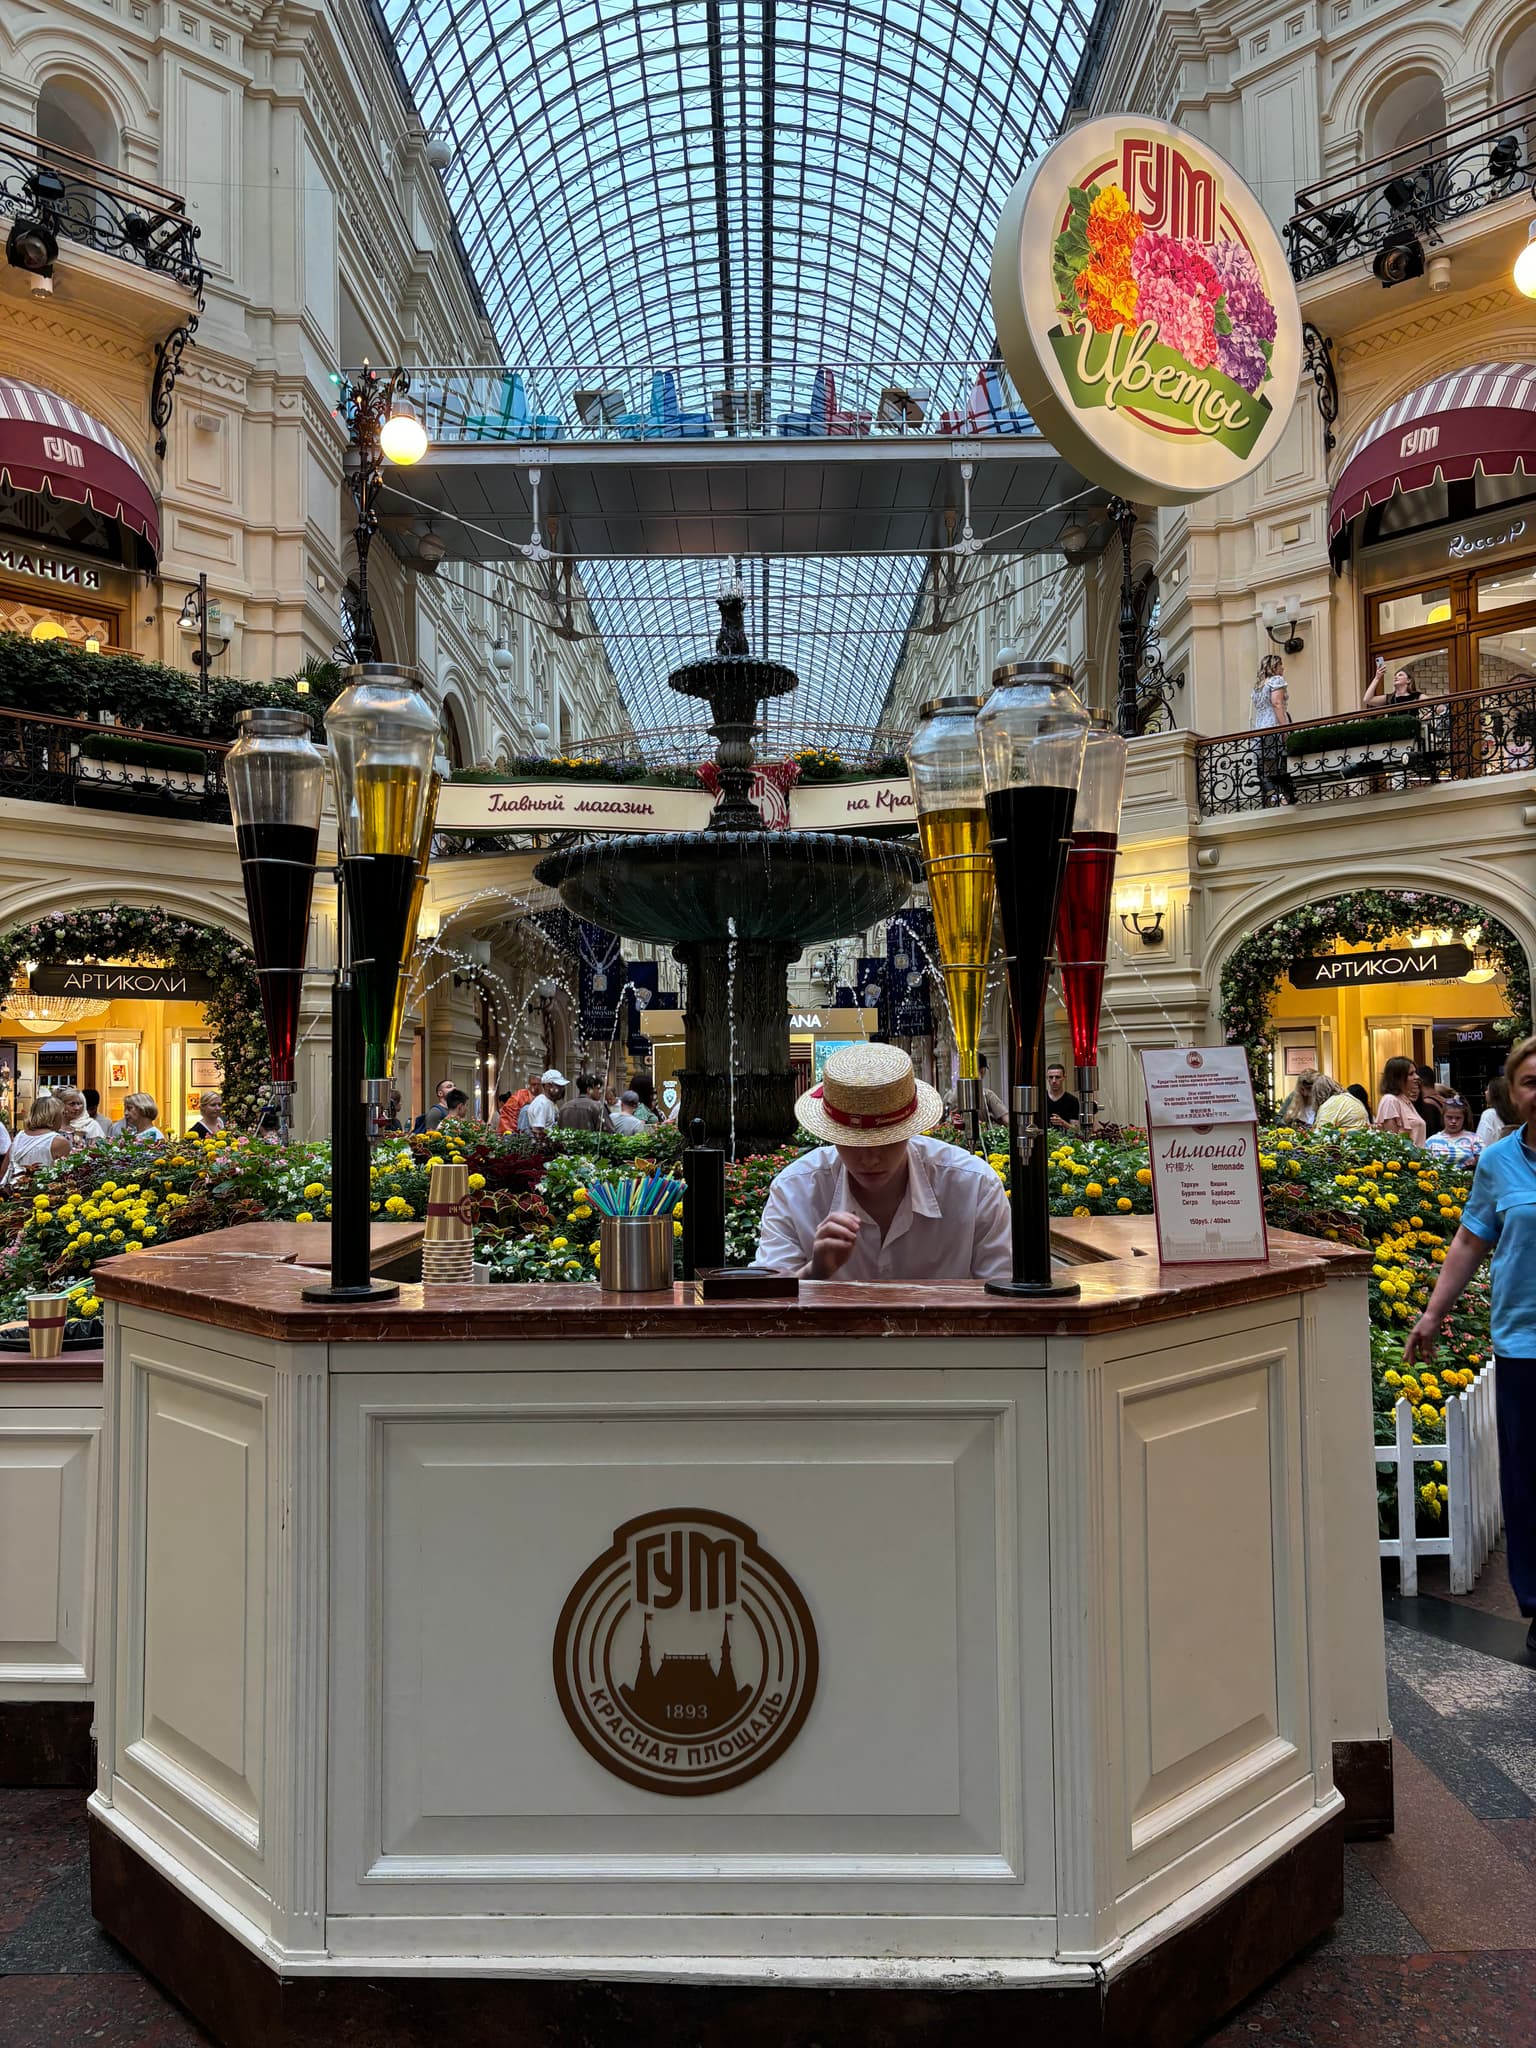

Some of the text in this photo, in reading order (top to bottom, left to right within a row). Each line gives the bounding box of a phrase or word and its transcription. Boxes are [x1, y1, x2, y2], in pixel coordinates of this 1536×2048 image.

[1074, 317, 1250, 435] Цветы
[488, 793, 654, 815] Главный магазин
[847, 799, 870, 811] на
[1315, 954, 1438, 980] АРТИКОЛИ
[64, 973, 186, 992] АРТИКОЛИ
[1162, 1138, 1247, 1158] Лимонад
[1211, 1161, 1245, 1171] lemonade
[665, 1704, 709, 1720] 1893
[589, 1689, 784, 1766] КРАСНАЯ ПЛОЩАДЬ
